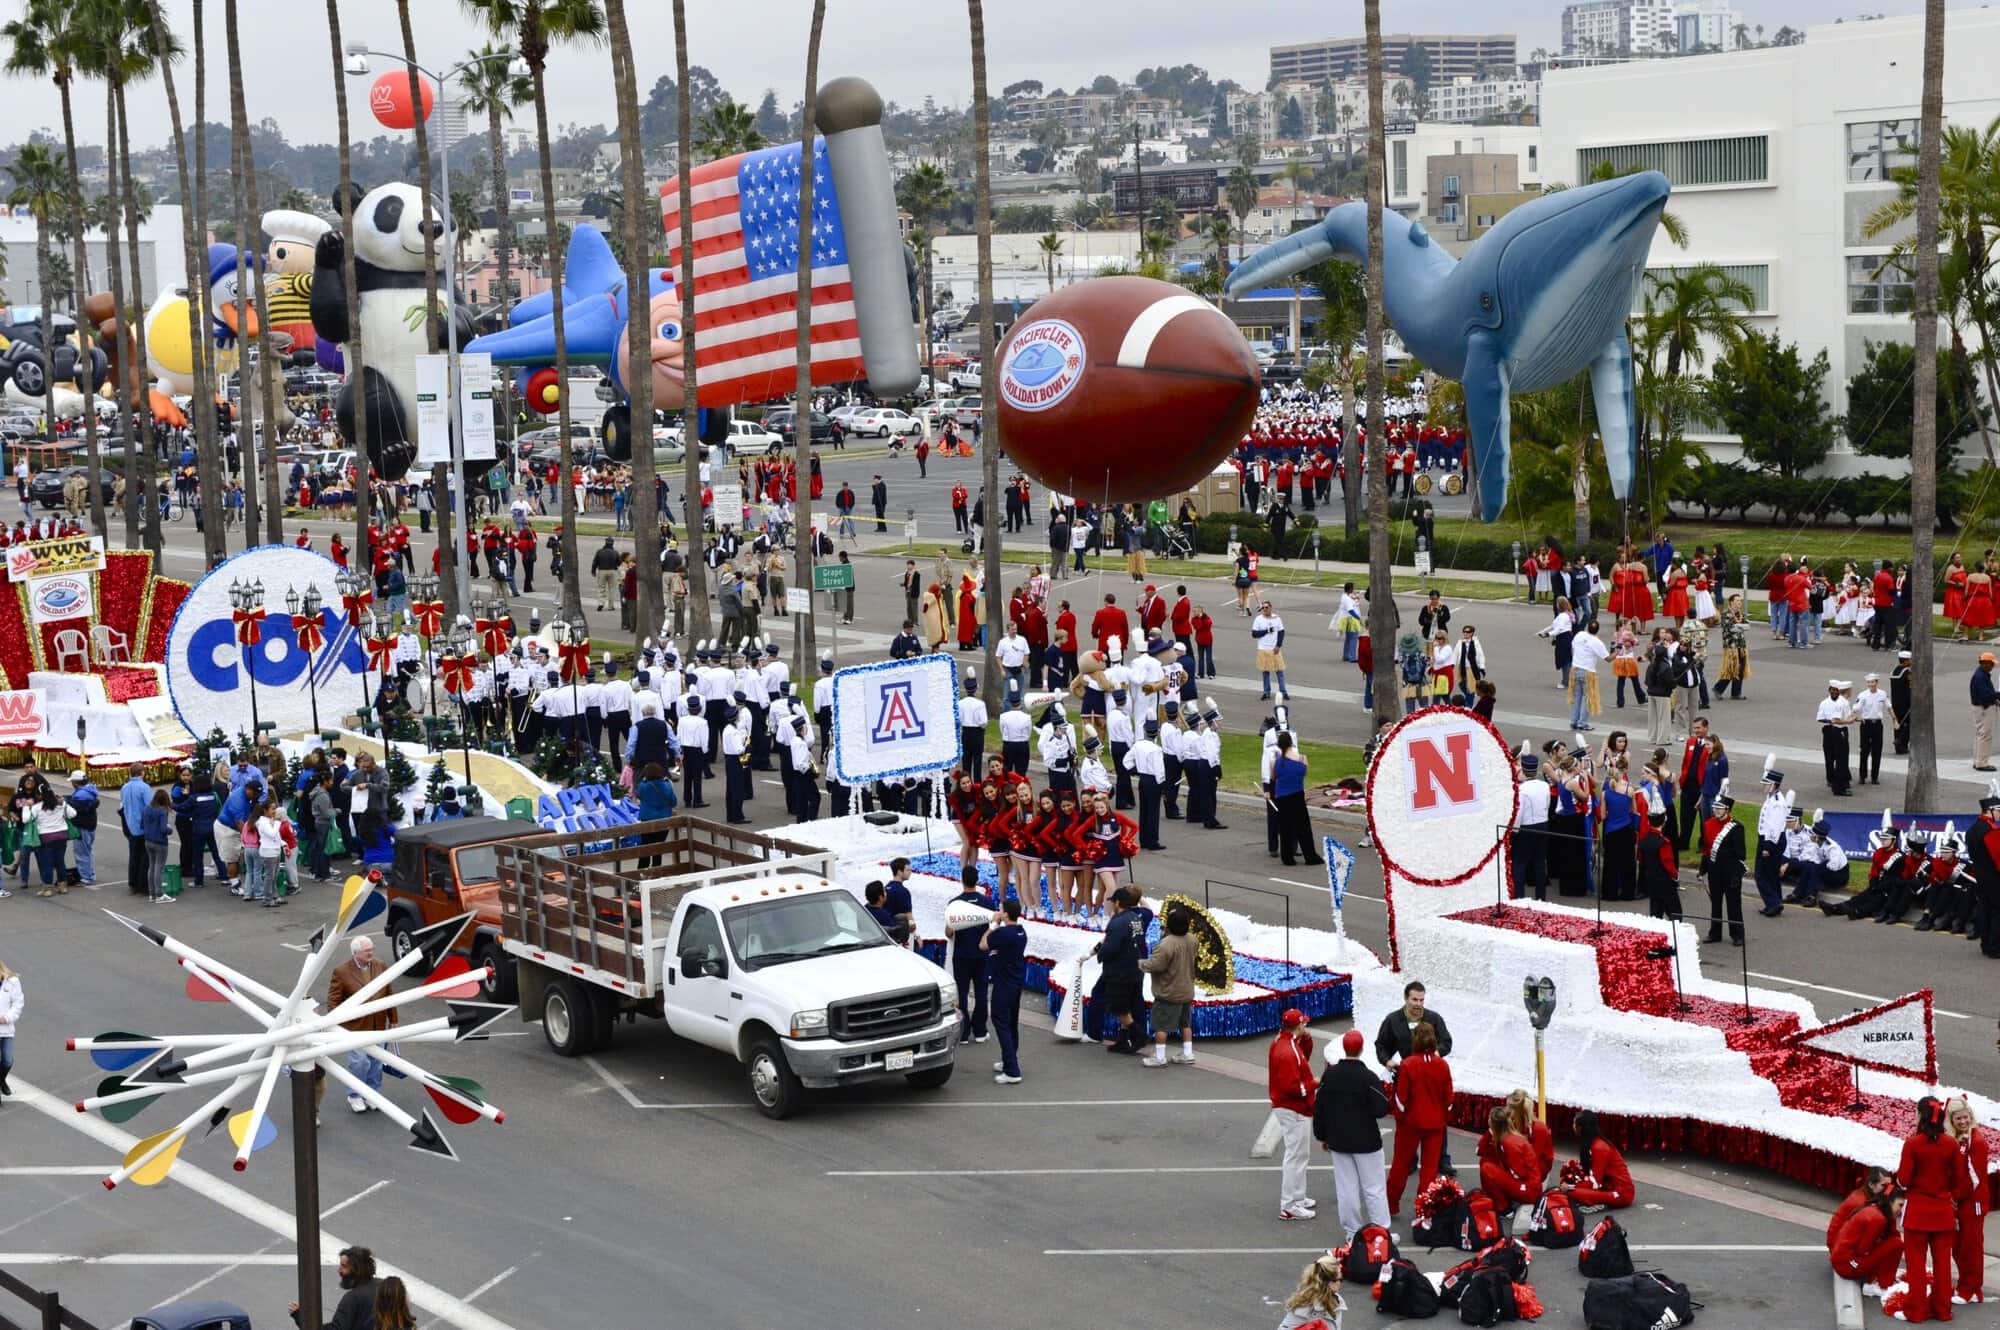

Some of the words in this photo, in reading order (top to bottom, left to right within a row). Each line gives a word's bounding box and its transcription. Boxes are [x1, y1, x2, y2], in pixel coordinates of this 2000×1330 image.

[1004, 376, 1038, 403] HOLIDAY
[1040, 374, 1071, 401] BOWL
[30, 540, 91, 560] WWN
[823, 569, 843, 577] Grape
[823, 577, 845, 586] Street
[40, 602, 66, 615] HOLIDAY
[67, 600, 84, 615] BOWL
[187, 606, 372, 693] COX
[872, 681, 925, 744] A
[1407, 731, 1477, 811] N
[537, 783, 613, 824] APPY
[1863, 1031, 1914, 1042] NEBRASKA
